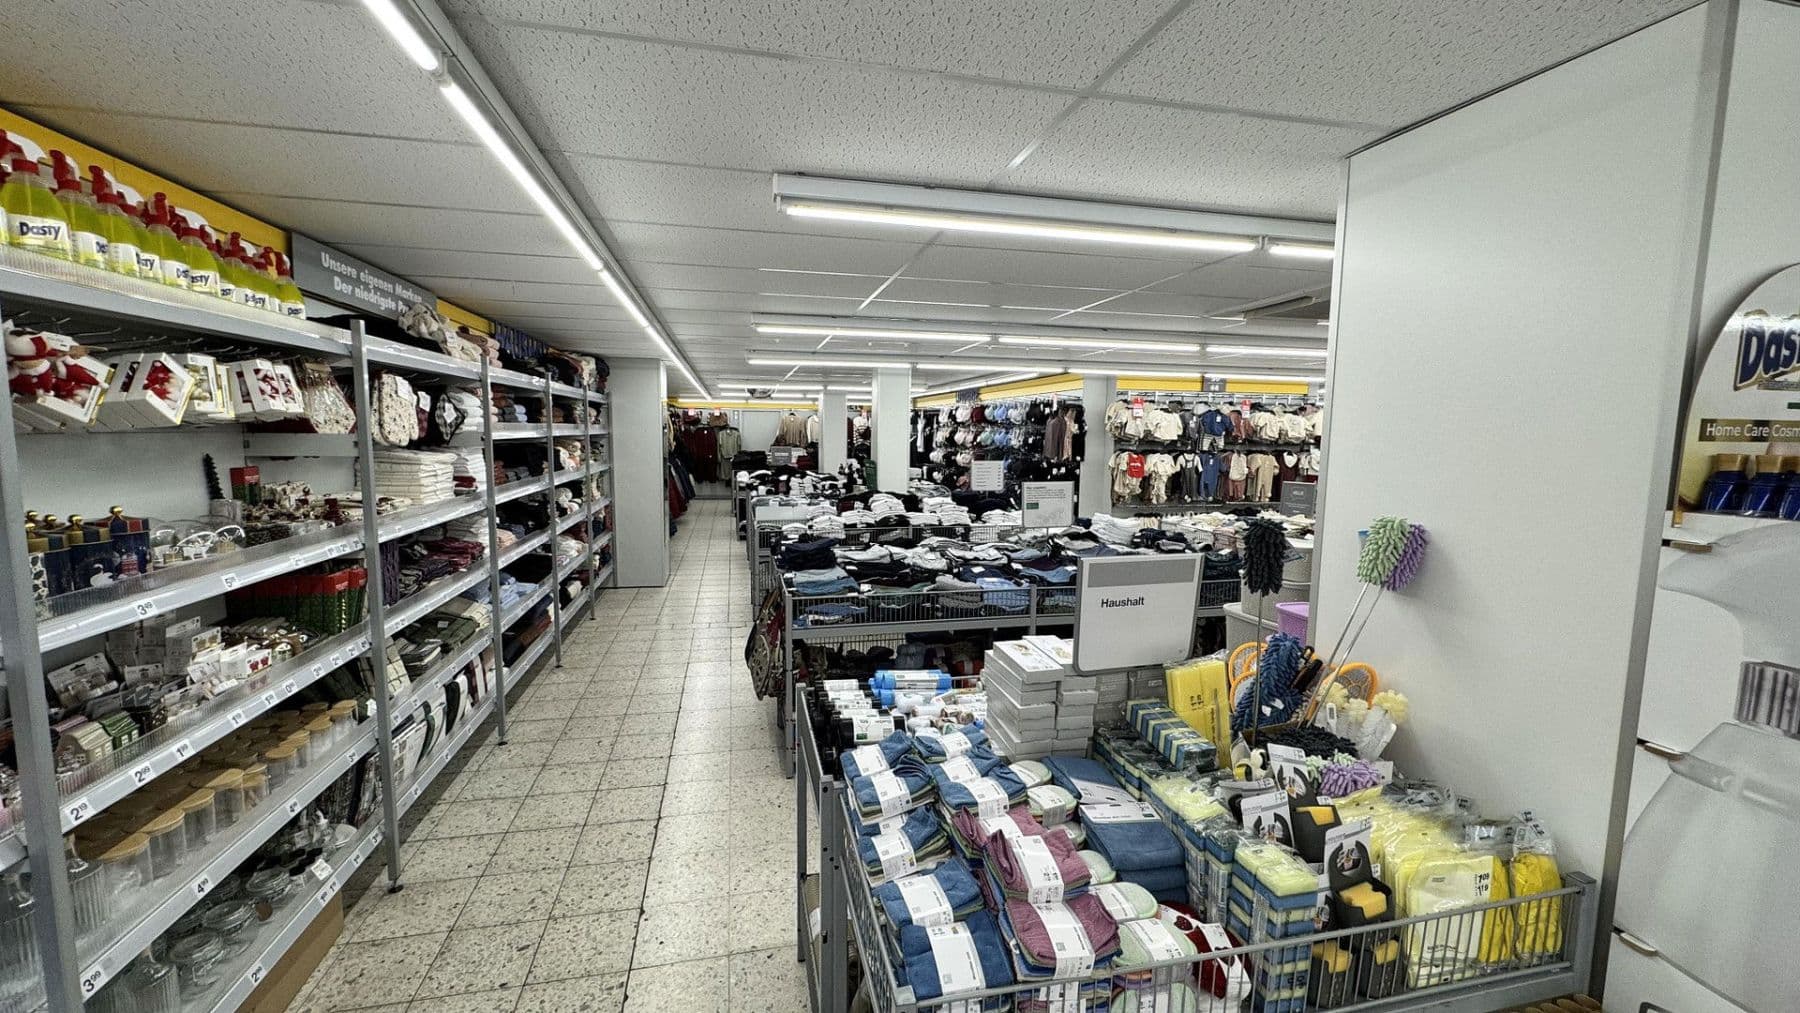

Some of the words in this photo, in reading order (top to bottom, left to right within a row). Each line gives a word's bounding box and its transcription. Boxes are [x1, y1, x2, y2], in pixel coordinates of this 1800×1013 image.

[19, 222, 61, 240] Dasty
[320, 251, 357, 279] Unsere
[359, 268, 394, 293] eigenen
[395, 281, 423, 302] Marken
[333, 275, 353, 295] Der
[354, 285, 397, 311] niedrigste
[1706, 423, 1742, 436] Home
[1744, 423, 1770, 437] Care
[1100, 596, 1145, 608] Haushalt
